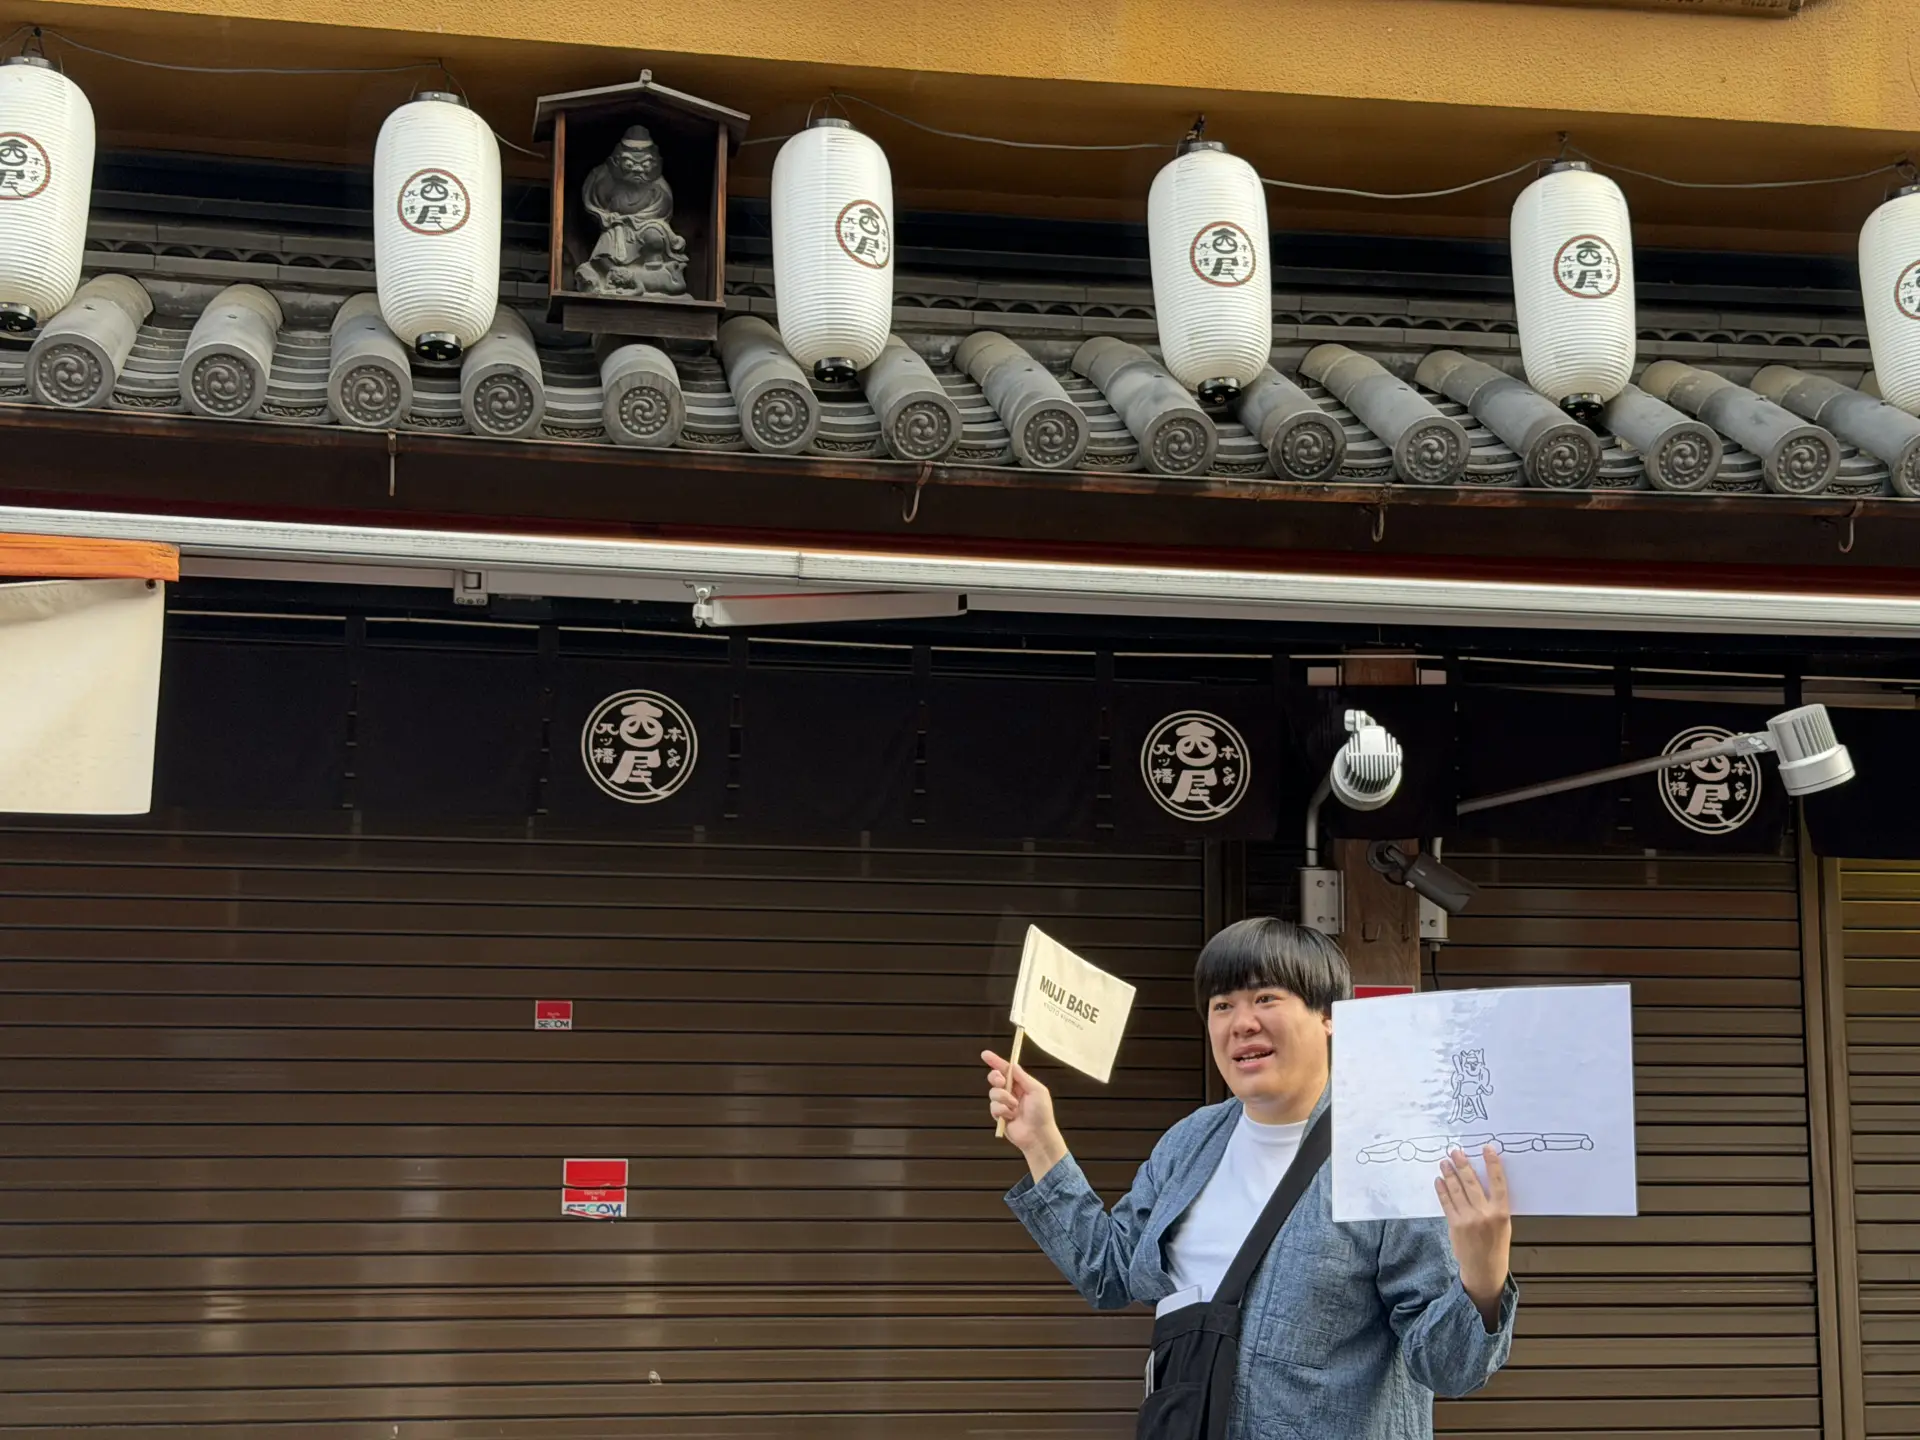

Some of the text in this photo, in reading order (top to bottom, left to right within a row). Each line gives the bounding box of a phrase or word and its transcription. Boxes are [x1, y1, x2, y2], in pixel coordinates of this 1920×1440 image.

[1040, 975, 1100, 1024] MUJI BASE
[538, 1020, 570, 1029] SECOM
